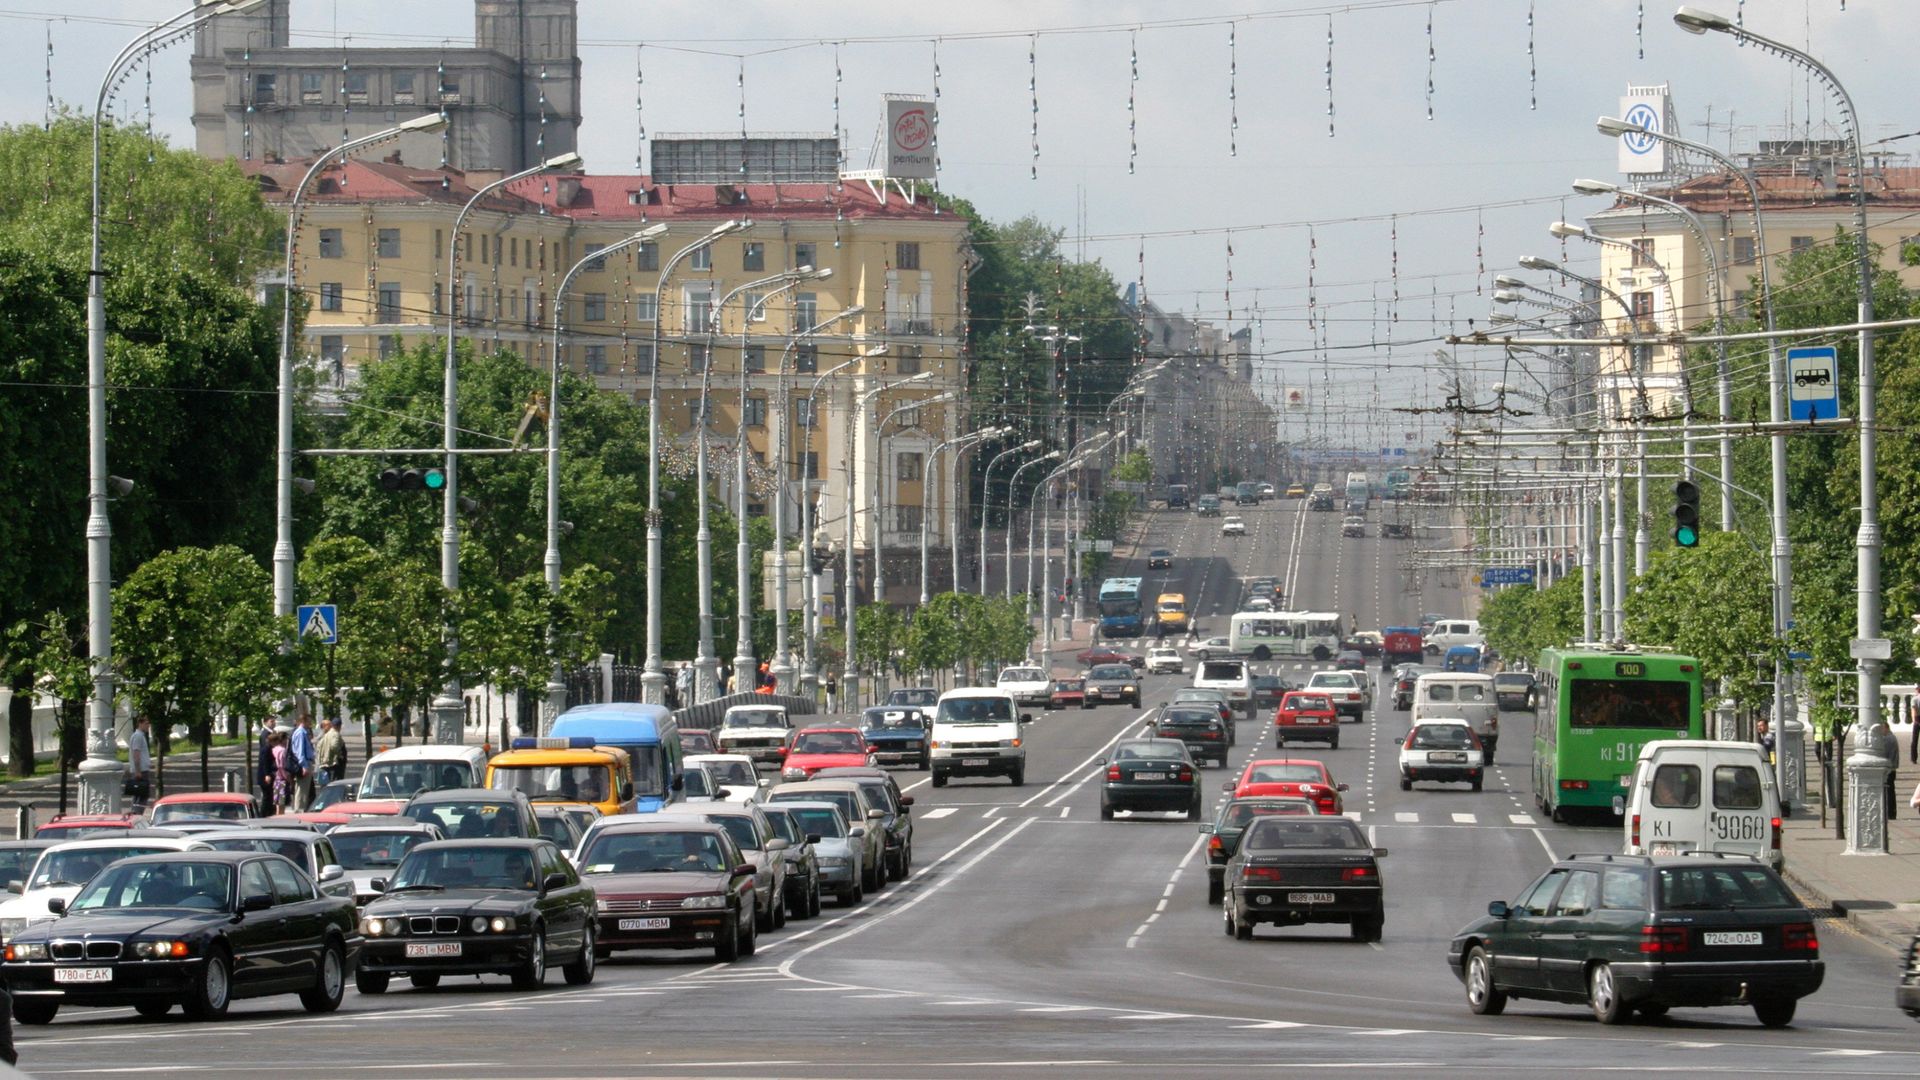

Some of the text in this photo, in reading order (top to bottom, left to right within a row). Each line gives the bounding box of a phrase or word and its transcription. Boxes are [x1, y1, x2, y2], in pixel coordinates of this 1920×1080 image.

[893, 154, 930, 165] pentium
[1621, 664, 1640, 675] 100
[620, 918, 669, 929] 0770 MBM
[1706, 934, 1729, 944] 7242
[436, 943, 460, 954] MBM
[57, 969, 109, 980] 1780 EAK
